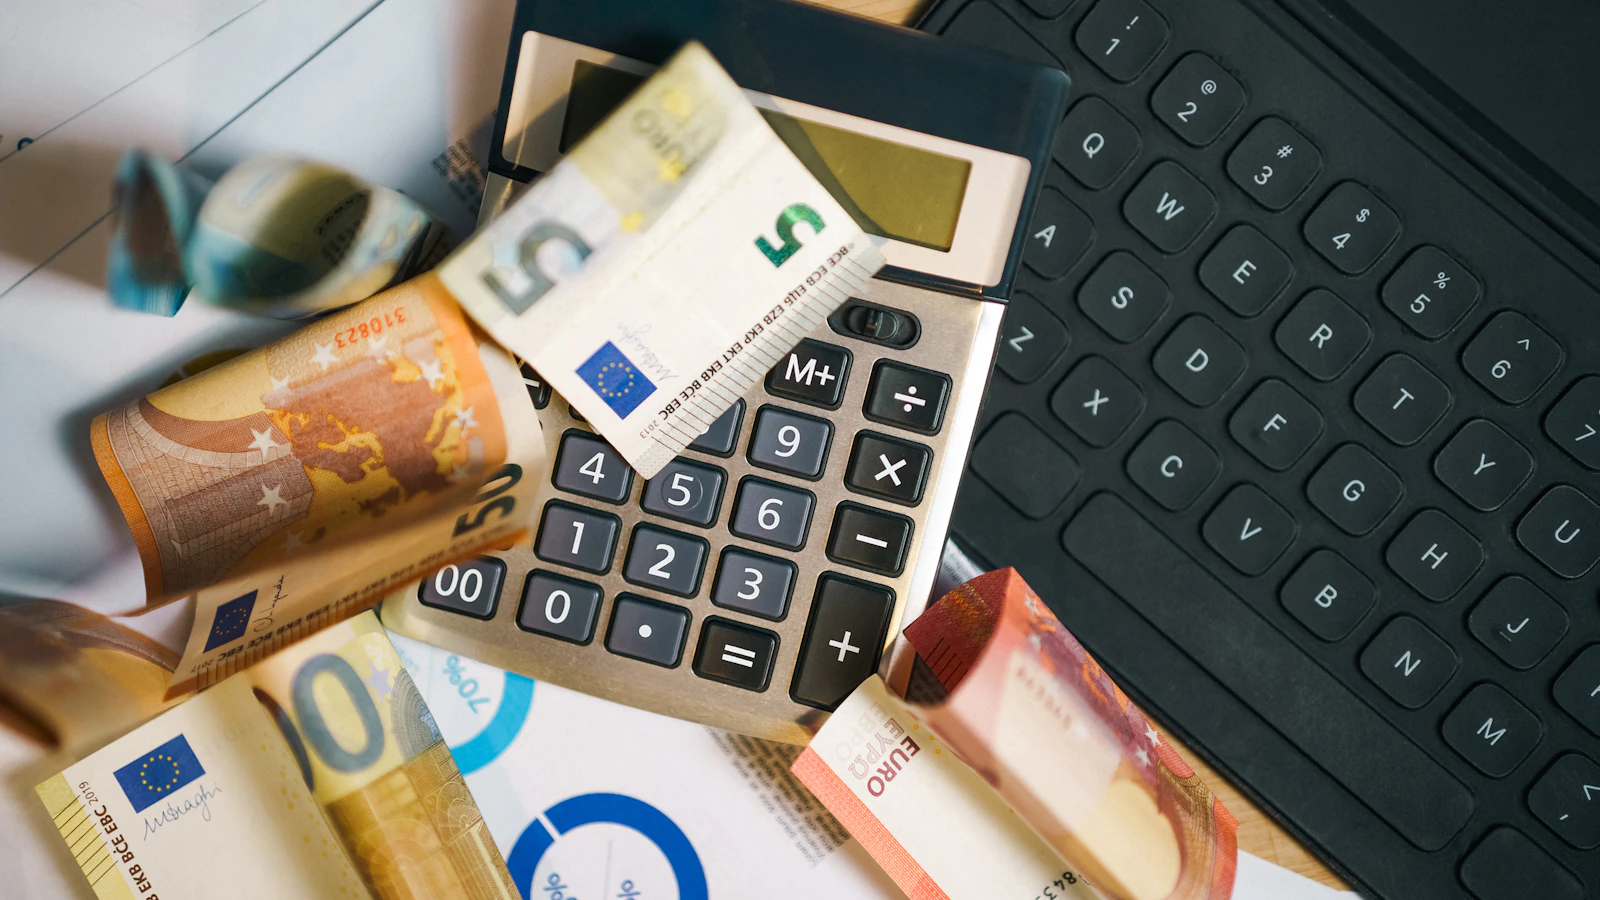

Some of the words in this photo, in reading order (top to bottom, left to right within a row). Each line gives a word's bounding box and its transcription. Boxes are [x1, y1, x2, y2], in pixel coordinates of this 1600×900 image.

[1126, 15, 1139, 30] !
[1105, 37, 1122, 55] 1
[1200, 79, 1217, 95] @
[1177, 101, 1197, 123] 2
[1082, 132, 1105, 159] Q
[1276, 144, 1293, 159] #
[1254, 165, 1273, 185] 3
[1156, 192, 1185, 221] W
[1355, 208, 1371, 223] $
[754, 203, 825, 268] 5
[1034, 224, 1057, 248] A
[1332, 232, 1351, 250] 4
[480, 220, 592, 315] 5
[827, 245, 849, 267] BCE
[806, 264, 828, 287] ECB
[1232, 260, 1257, 285] E
[1433, 271, 1451, 289] %
[1111, 286, 1134, 309] S
[1410, 293, 1431, 314] 5
[334, 306, 407, 348] 310823
[763, 304, 785, 326] EZB
[743, 324, 765, 345] EKP
[1009, 326, 1035, 352] Z
[1309, 323, 1333, 349] R
[1517, 338, 1530, 351] ^
[722, 341, 744, 364] EKT
[1185, 348, 1209, 372] D
[700, 360, 724, 383] EKB
[784, 352, 837, 387] M+
[1491, 359, 1511, 379] 6
[658, 398, 682, 421] EBC
[894, 386, 926, 413] ÷
[1083, 388, 1109, 416] X
[1392, 387, 1415, 410] T
[639, 419, 659, 439] 2013
[1263, 413, 1287, 432] F
[1575, 424, 1597, 441] 7
[774, 425, 801, 458] 9
[578, 452, 605, 485] 4
[1161, 455, 1183, 478] C
[1473, 453, 1496, 475] Y
[453, 463, 523, 538] 50
[667, 472, 694, 506] 5
[1342, 479, 1365, 502] G
[757, 498, 784, 531] 6
[571, 521, 585, 555] 1
[1240, 517, 1262, 541] V
[1554, 519, 1581, 544] U
[648, 543, 676, 580] 2
[1420, 543, 1449, 570] H
[434, 563, 484, 604] 00
[736, 567, 763, 600] 3
[544, 589, 571, 624] 0
[1314, 584, 1338, 608] B
[276, 617, 302, 635] EKB
[1506, 617, 1530, 634] J
[216, 644, 244, 663] EBC
[721, 644, 756, 668] =
[828, 630, 860, 662] +
[190, 658, 214, 674] 2017
[1394, 650, 1421, 677] N
[442, 654, 491, 714] 70%
[1476, 717, 1507, 746] M
[867, 735, 921, 798] EURO
[78, 781, 98, 806] 2019
[94, 804, 118, 835] EBC
[128, 863, 152, 894] EKB
